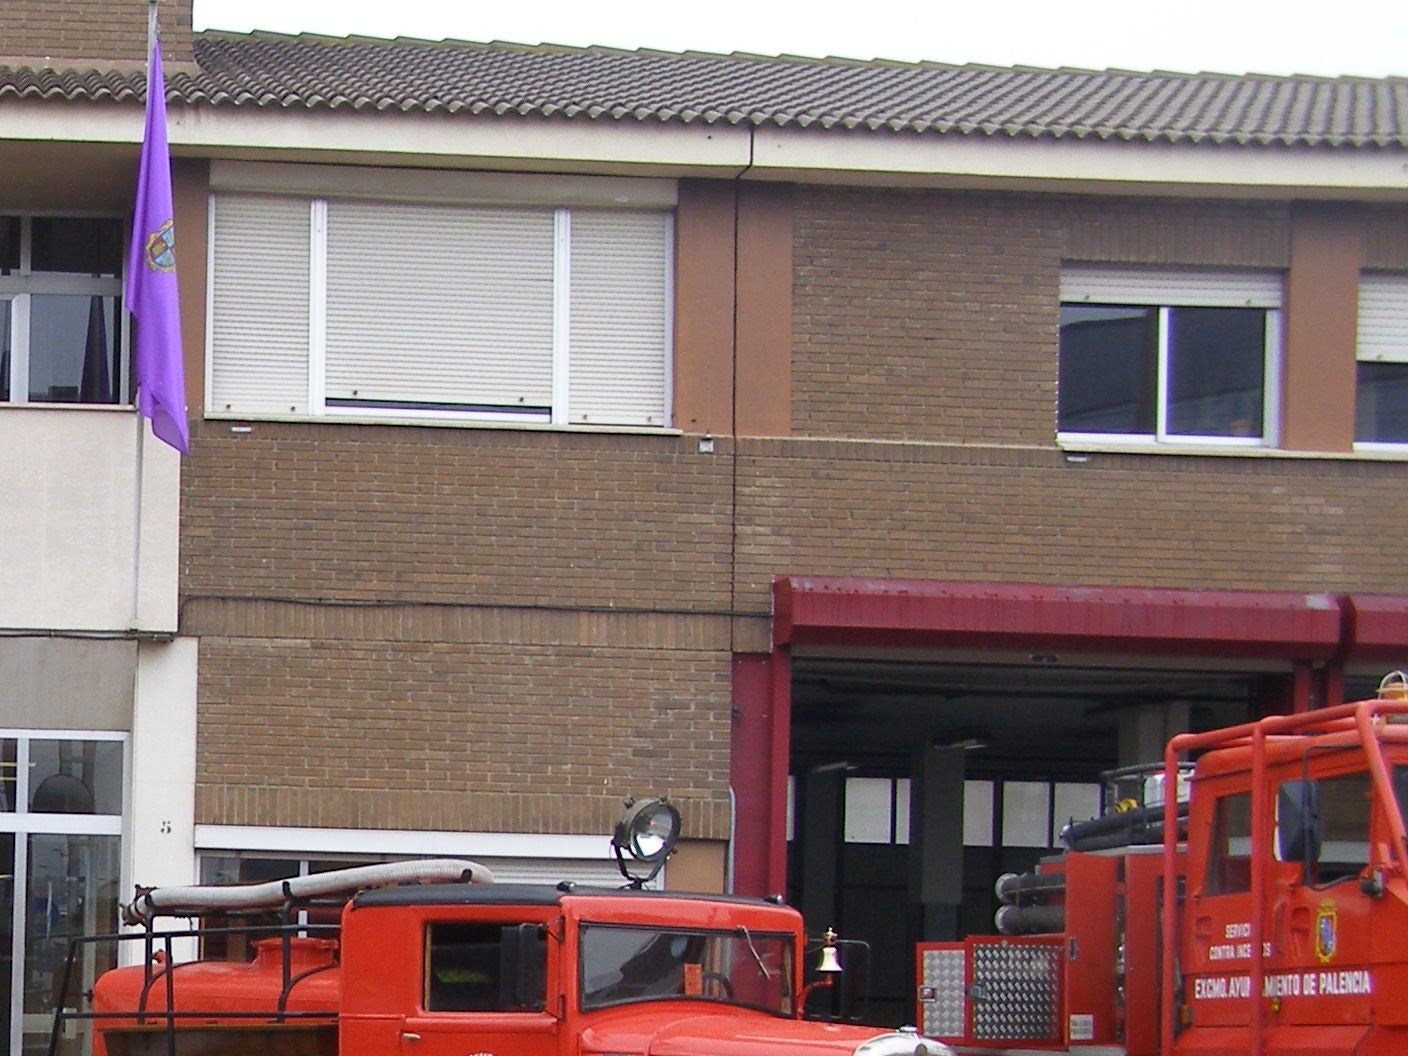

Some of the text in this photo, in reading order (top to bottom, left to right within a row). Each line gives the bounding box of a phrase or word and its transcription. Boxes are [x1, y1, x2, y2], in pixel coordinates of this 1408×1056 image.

[1225, 923, 1251, 939] SERVICI
[1209, 942, 1272, 960] CONTRA INCEOS
[1229, 974, 1300, 998] AYUMIENTO
[1302, 973, 1317, 996] DE
[1319, 970, 1372, 995] PALENCIA
